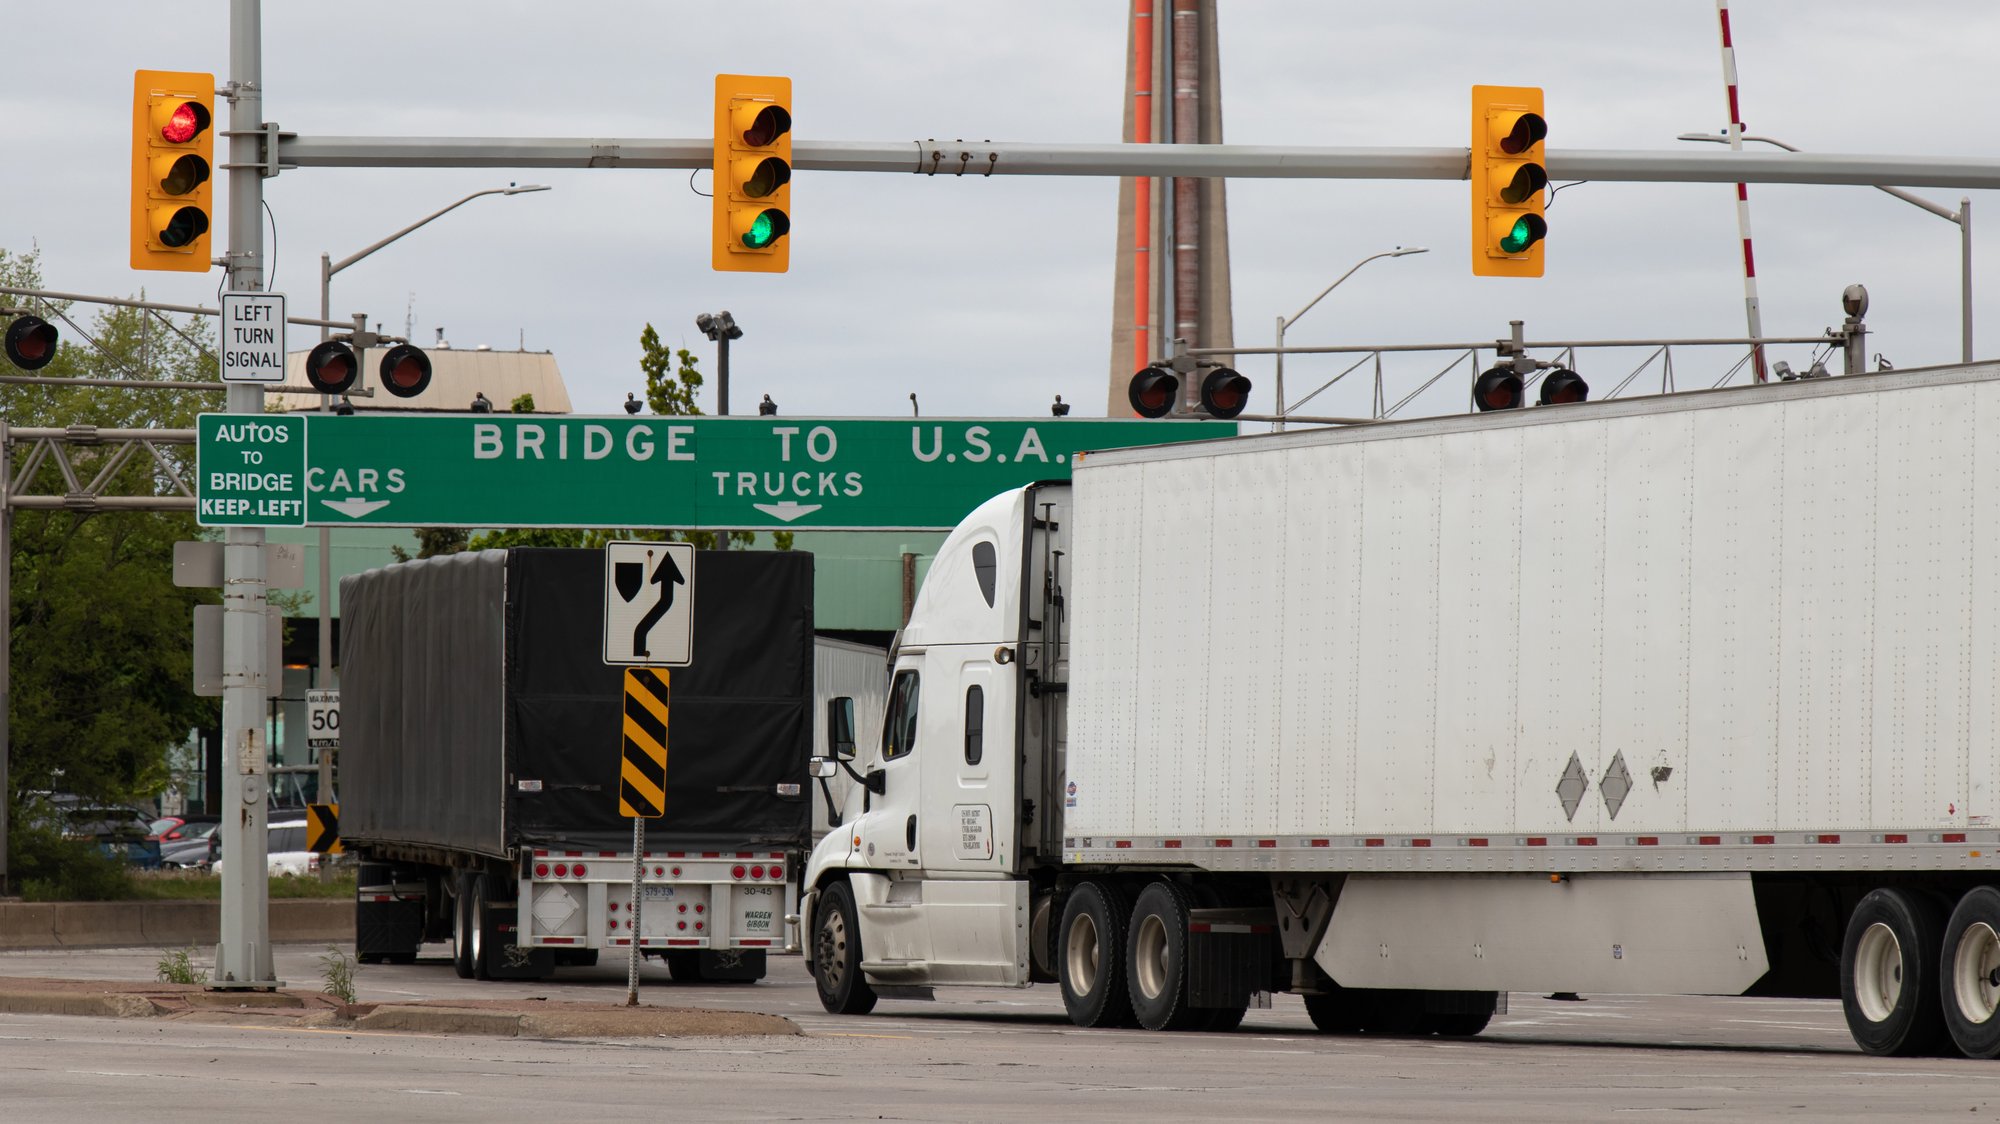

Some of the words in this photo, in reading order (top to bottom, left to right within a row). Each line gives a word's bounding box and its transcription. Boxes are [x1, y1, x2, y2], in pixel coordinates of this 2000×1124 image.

[234, 305, 272, 322] LEFT
[234, 327, 274, 344] TURN
[226, 351, 281, 368] SIGNAL
[215, 423, 289, 443] AUTOS
[473, 424, 696, 461] BRIDGE
[773, 425, 838, 463] TO
[912, 425, 1066, 463] U.S.A.
[240, 450, 263, 465] TO
[210, 472, 293, 492] BRIDGE
[307, 467, 406, 493] CARS
[713, 471, 863, 497] TRUCKS
[201, 498, 250, 516] KEEP
[258, 499, 302, 517] LEFT
[312, 709, 340, 731] 50
[744, 887, 772, 896] 30-45
[745, 911, 773, 920] WARREN
[746, 920, 770, 929] GIBSON
